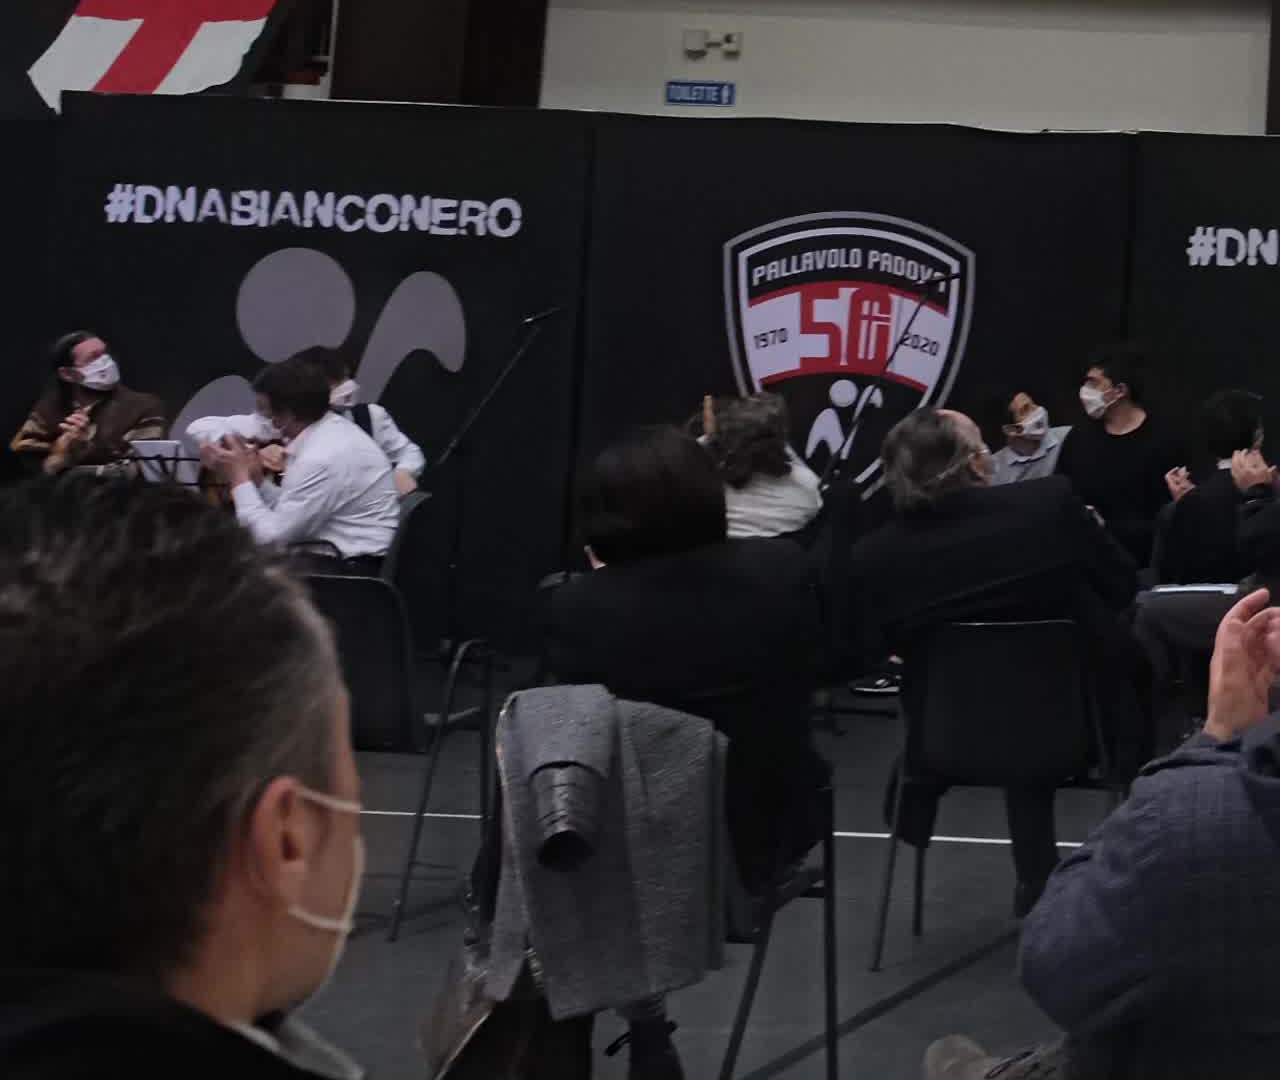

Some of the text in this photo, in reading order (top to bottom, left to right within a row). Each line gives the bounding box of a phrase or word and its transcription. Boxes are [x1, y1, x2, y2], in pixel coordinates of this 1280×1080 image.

[104, 182, 523, 238] #DNABIANCONERO
[752, 248, 862, 286] PALLAVOLO
[753, 328, 940, 357] 1970 2020
